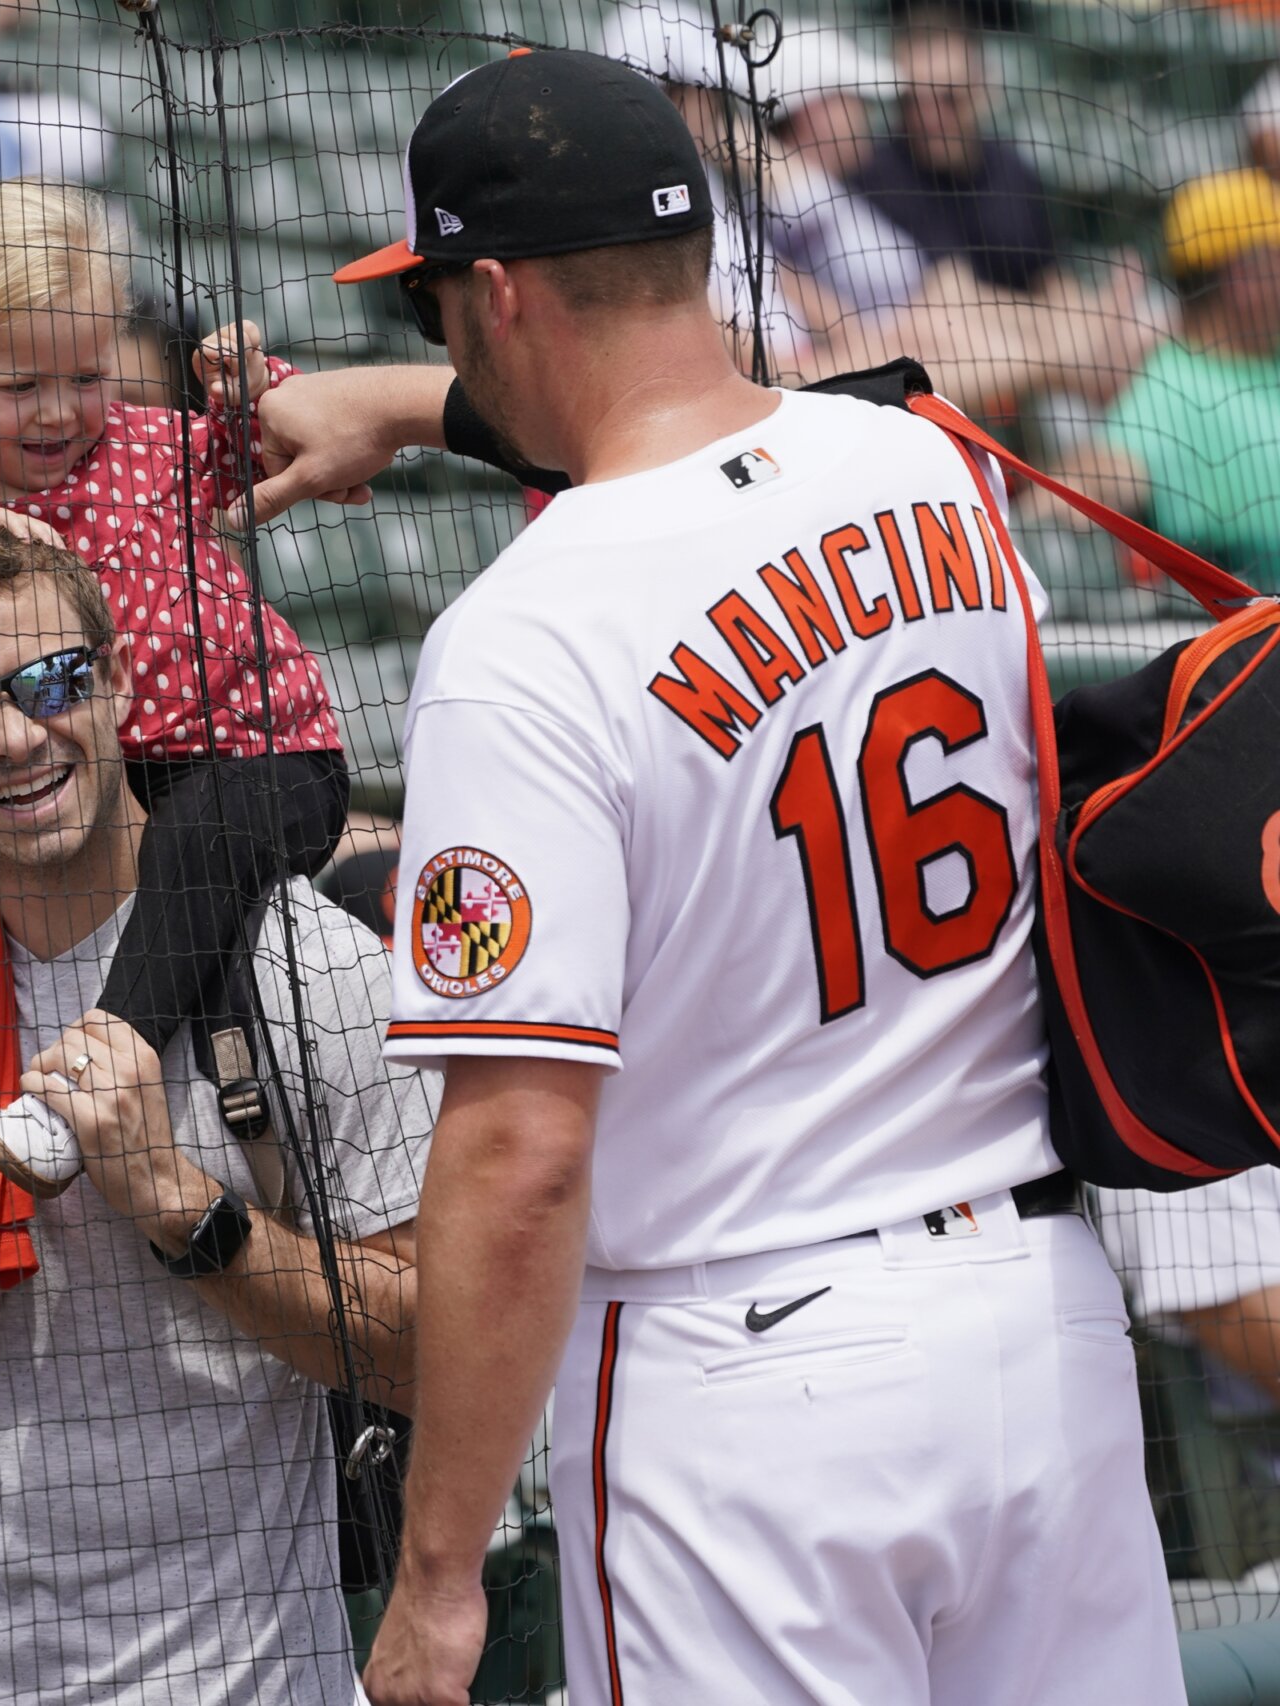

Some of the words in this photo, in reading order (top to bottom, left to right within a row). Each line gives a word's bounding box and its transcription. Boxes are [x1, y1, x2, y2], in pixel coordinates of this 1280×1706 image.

[648, 502, 1007, 760] MANCINI
[416, 849, 524, 902] BALTIMORE
[770, 668, 1018, 1025] 16
[419, 964, 507, 995] ORIOLES
